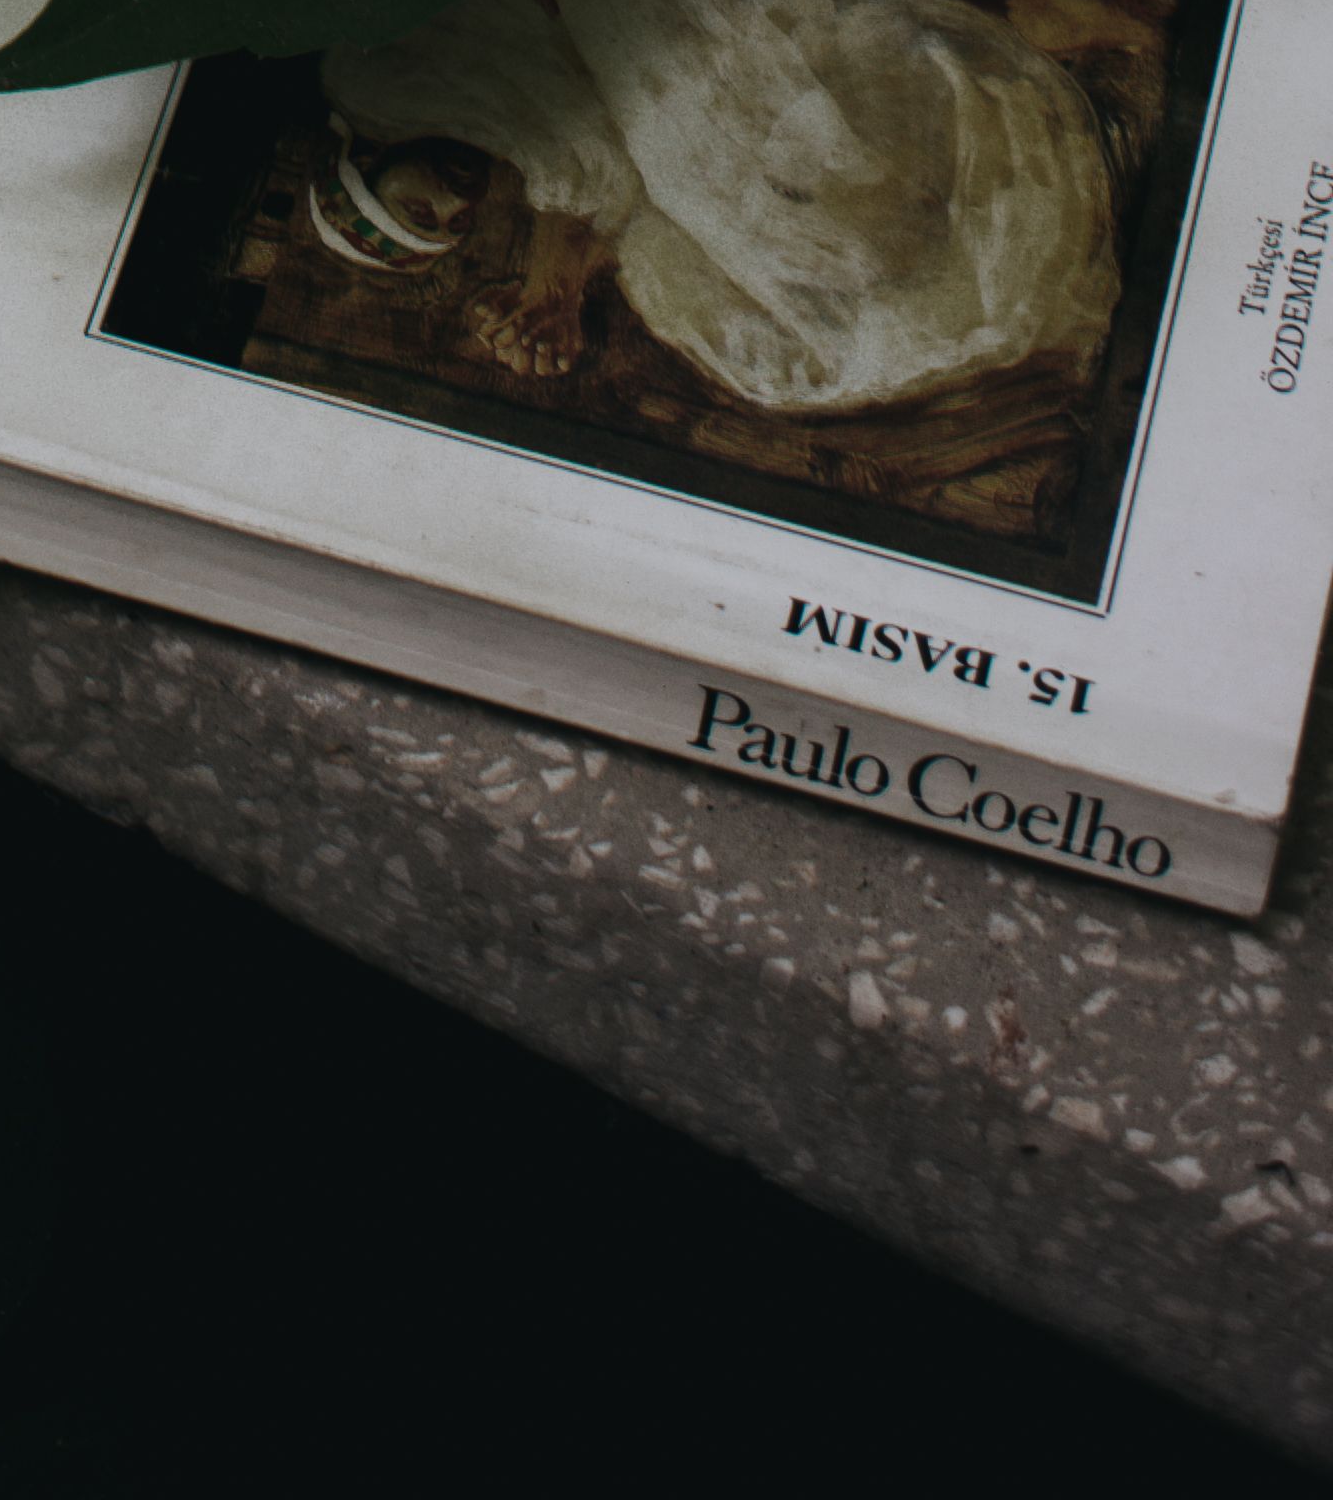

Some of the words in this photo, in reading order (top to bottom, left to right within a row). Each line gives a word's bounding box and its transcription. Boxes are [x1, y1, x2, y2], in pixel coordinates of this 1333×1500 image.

[1259, 248, 1324, 395] ÖZDEMİR
[781, 596, 997, 690] BASIM
[1017, 659, 1097, 714] 15.
[686, 682, 890, 798] Paulo
[907, 753, 1172, 878] Coelho
